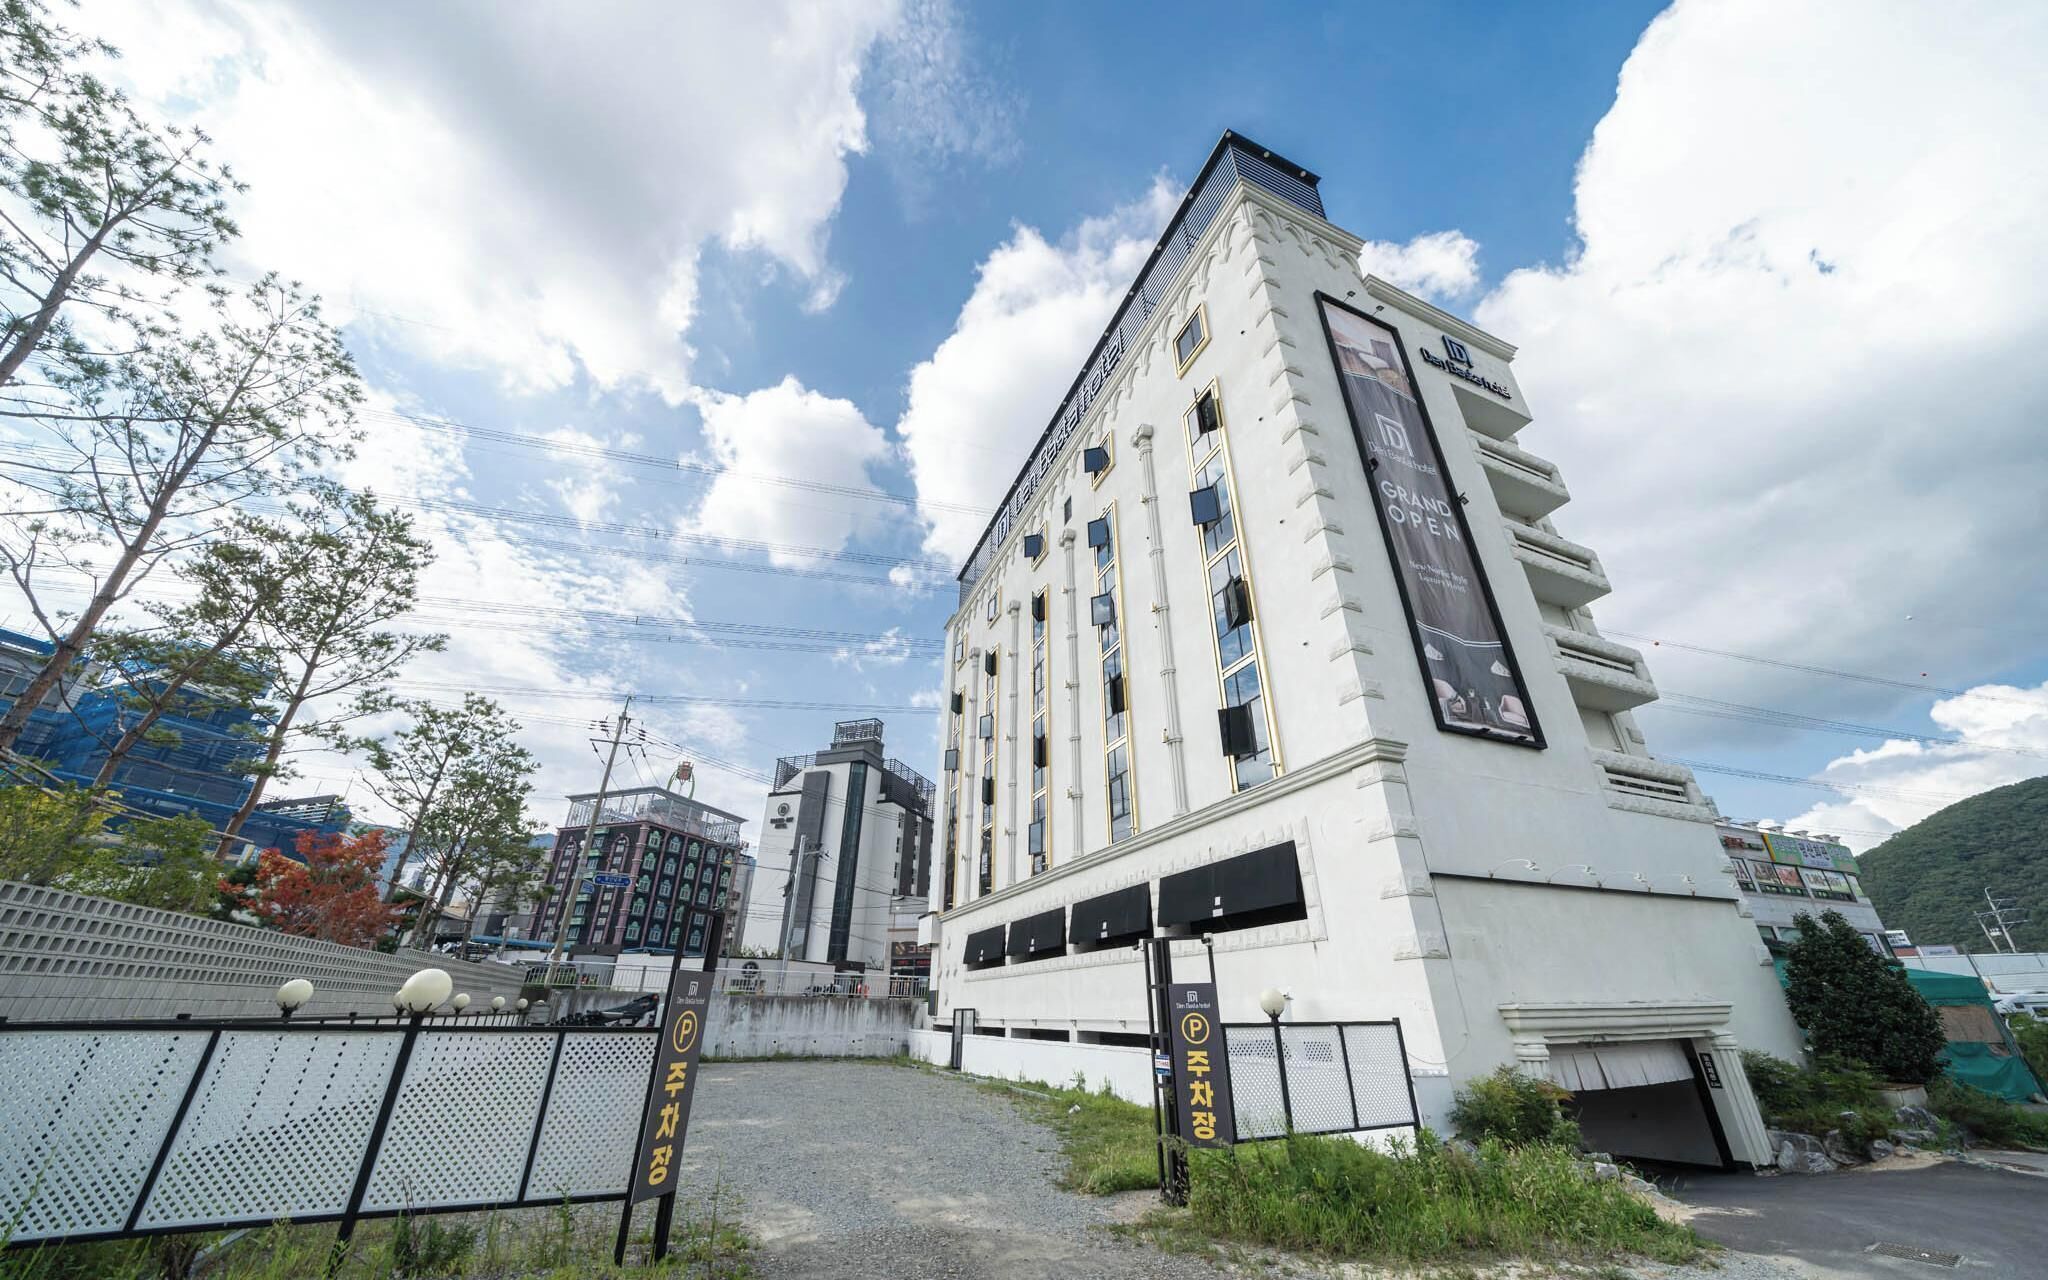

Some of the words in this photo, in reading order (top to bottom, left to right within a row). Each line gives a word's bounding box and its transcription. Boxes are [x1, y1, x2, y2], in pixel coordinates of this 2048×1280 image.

[1081, 327, 1124, 413] hotel
[1381, 480, 1451, 517] GRAND
[1388, 504, 1460, 542] OPEN
[680, 1019, 692, 1044] P
[1189, 1019, 1202, 1038] P
[1187, 1051, 1217, 1140] 주차장
[648, 1061, 688, 1186] 주차장
